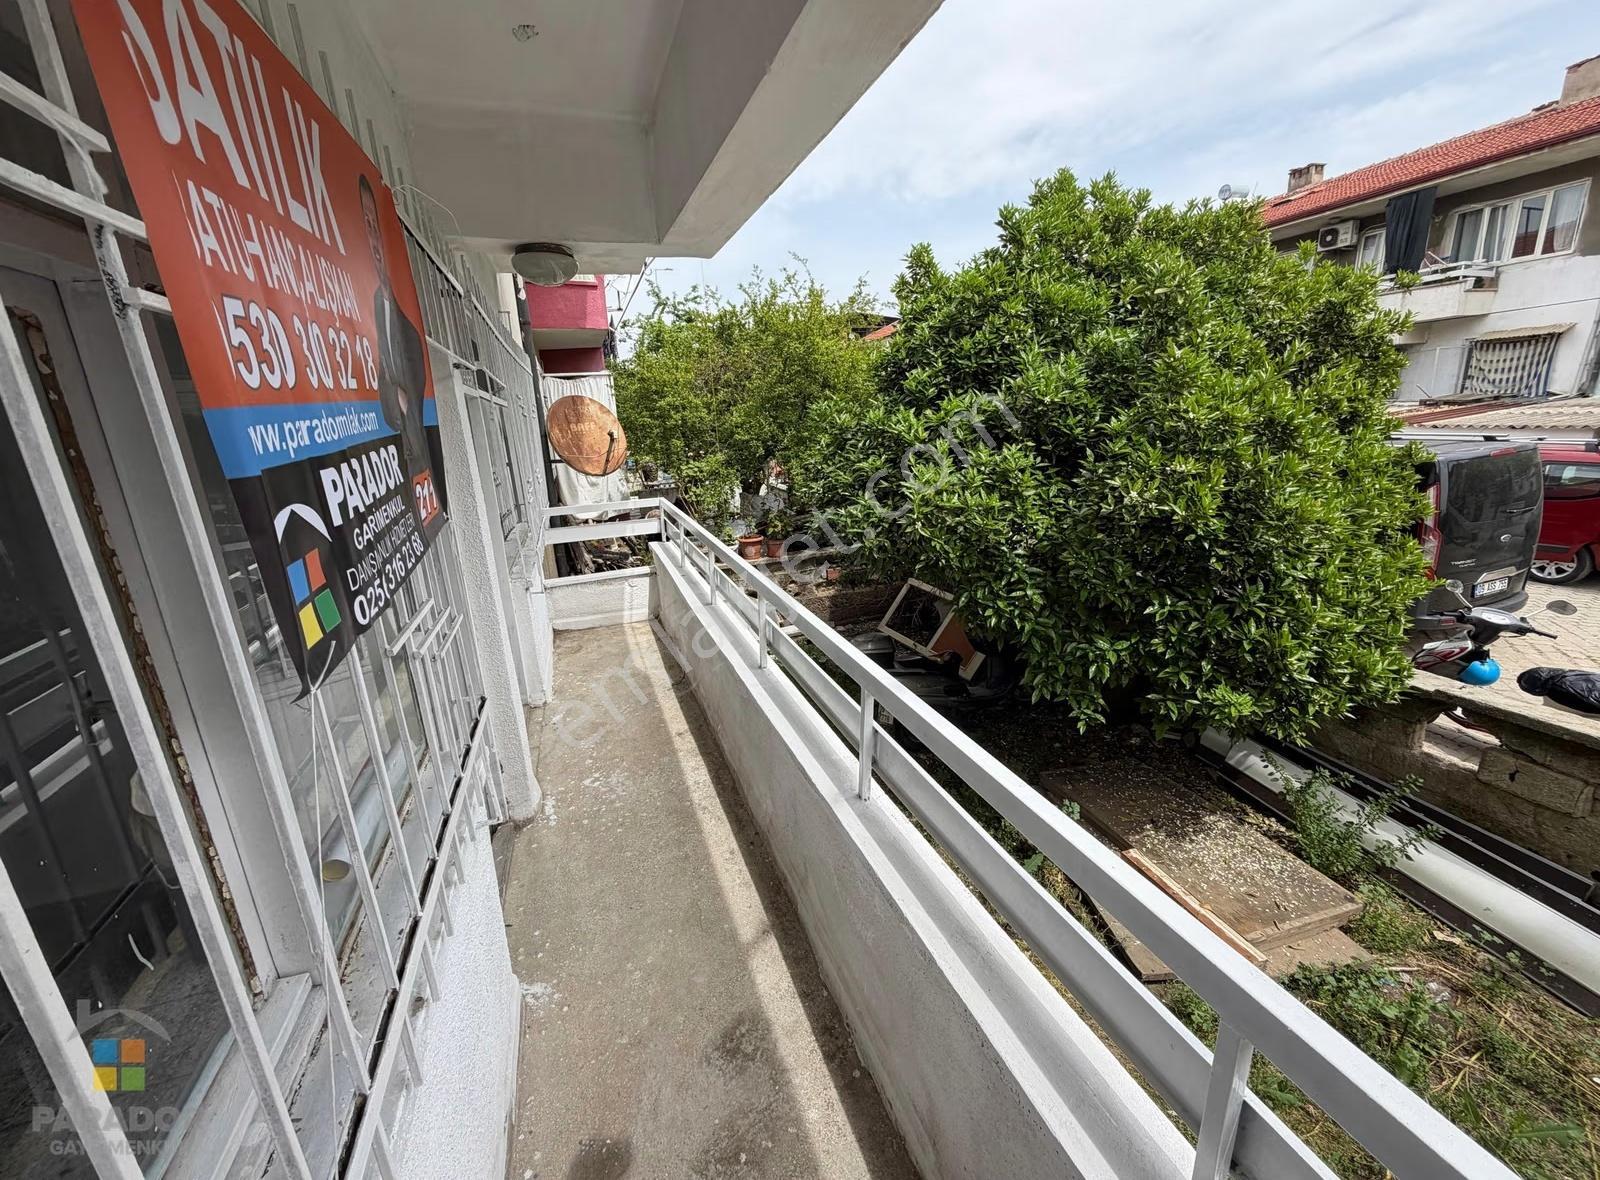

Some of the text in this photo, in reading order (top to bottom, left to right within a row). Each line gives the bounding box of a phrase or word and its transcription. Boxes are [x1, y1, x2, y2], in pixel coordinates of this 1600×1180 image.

[172, 169, 300, 298] ATUHAN
[211, 295, 379, 391] 530 30 32 18
[319, 444, 404, 527] PARADOR
[385, 552, 405, 590] 316
[402, 541, 416, 569] 23
[411, 531, 424, 557] 68
